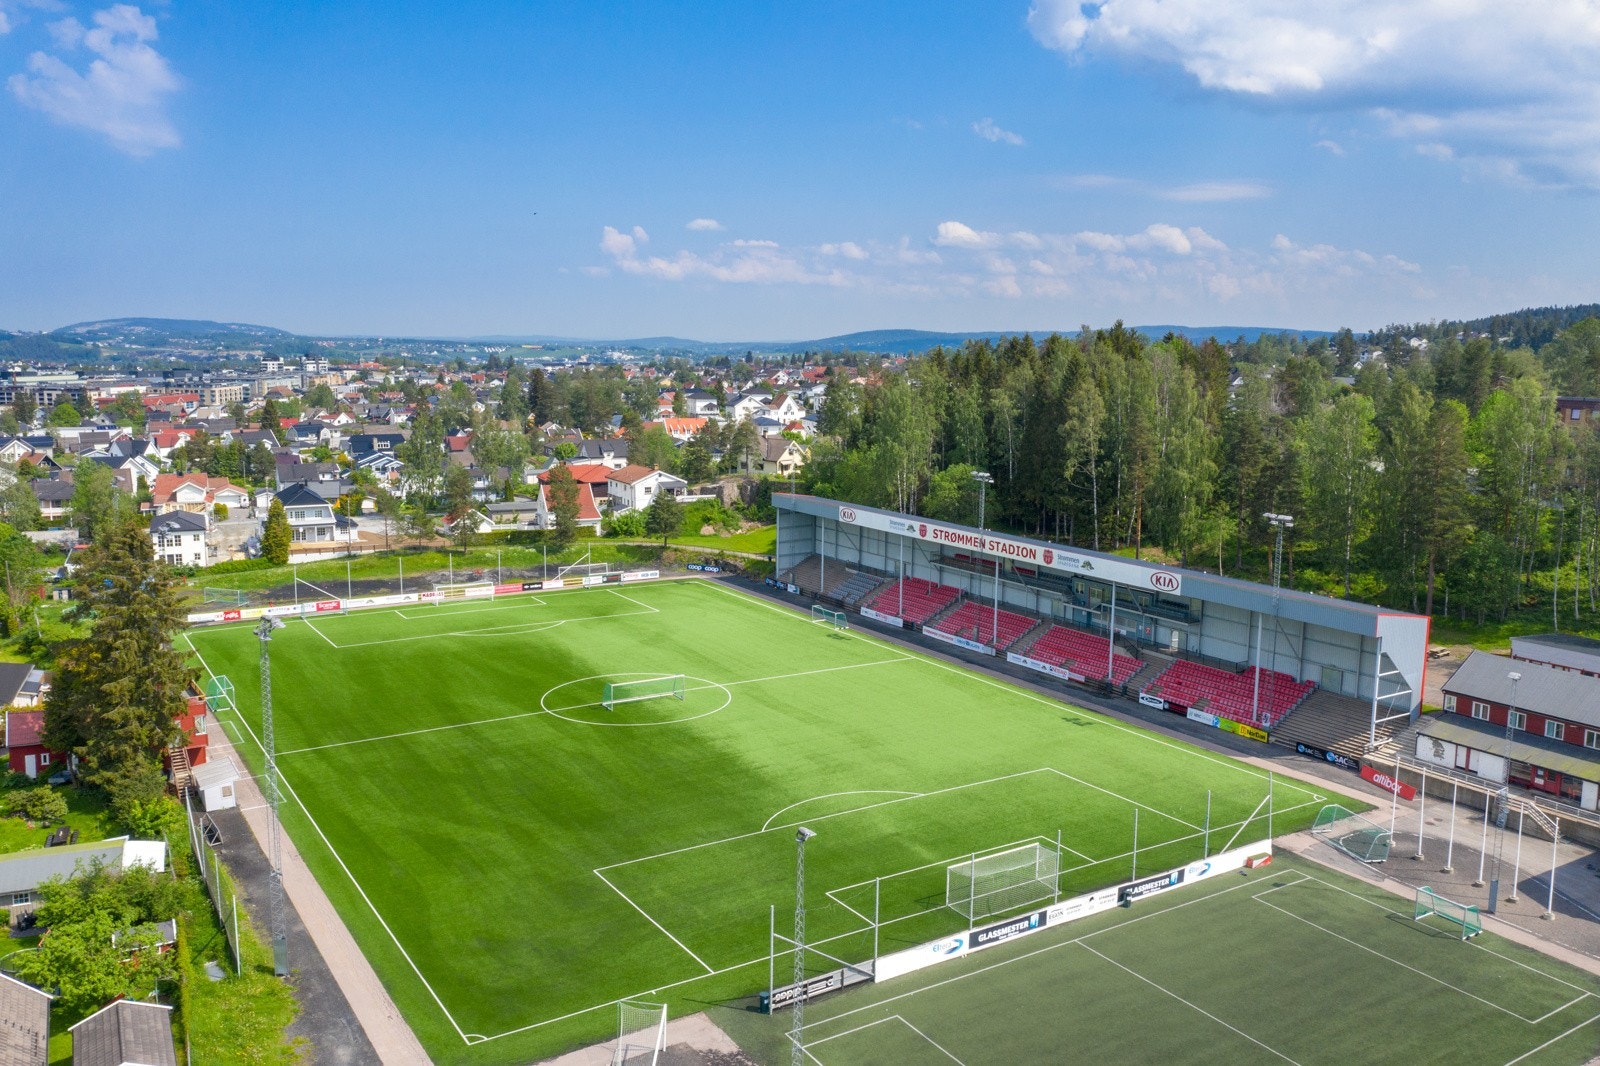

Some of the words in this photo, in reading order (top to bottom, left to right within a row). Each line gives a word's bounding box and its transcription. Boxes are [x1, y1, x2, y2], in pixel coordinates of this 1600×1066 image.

[842, 510, 854, 521] KIA
[932, 528, 986, 549] STRØMMEN
[988, 540, 1037, 560] STADION
[1155, 575, 1174, 589] KIA
[1335, 755, 1348, 765] SAC
[1373, 773, 1402, 793] altibox
[978, 920, 1029, 942] GLASSMESTER
